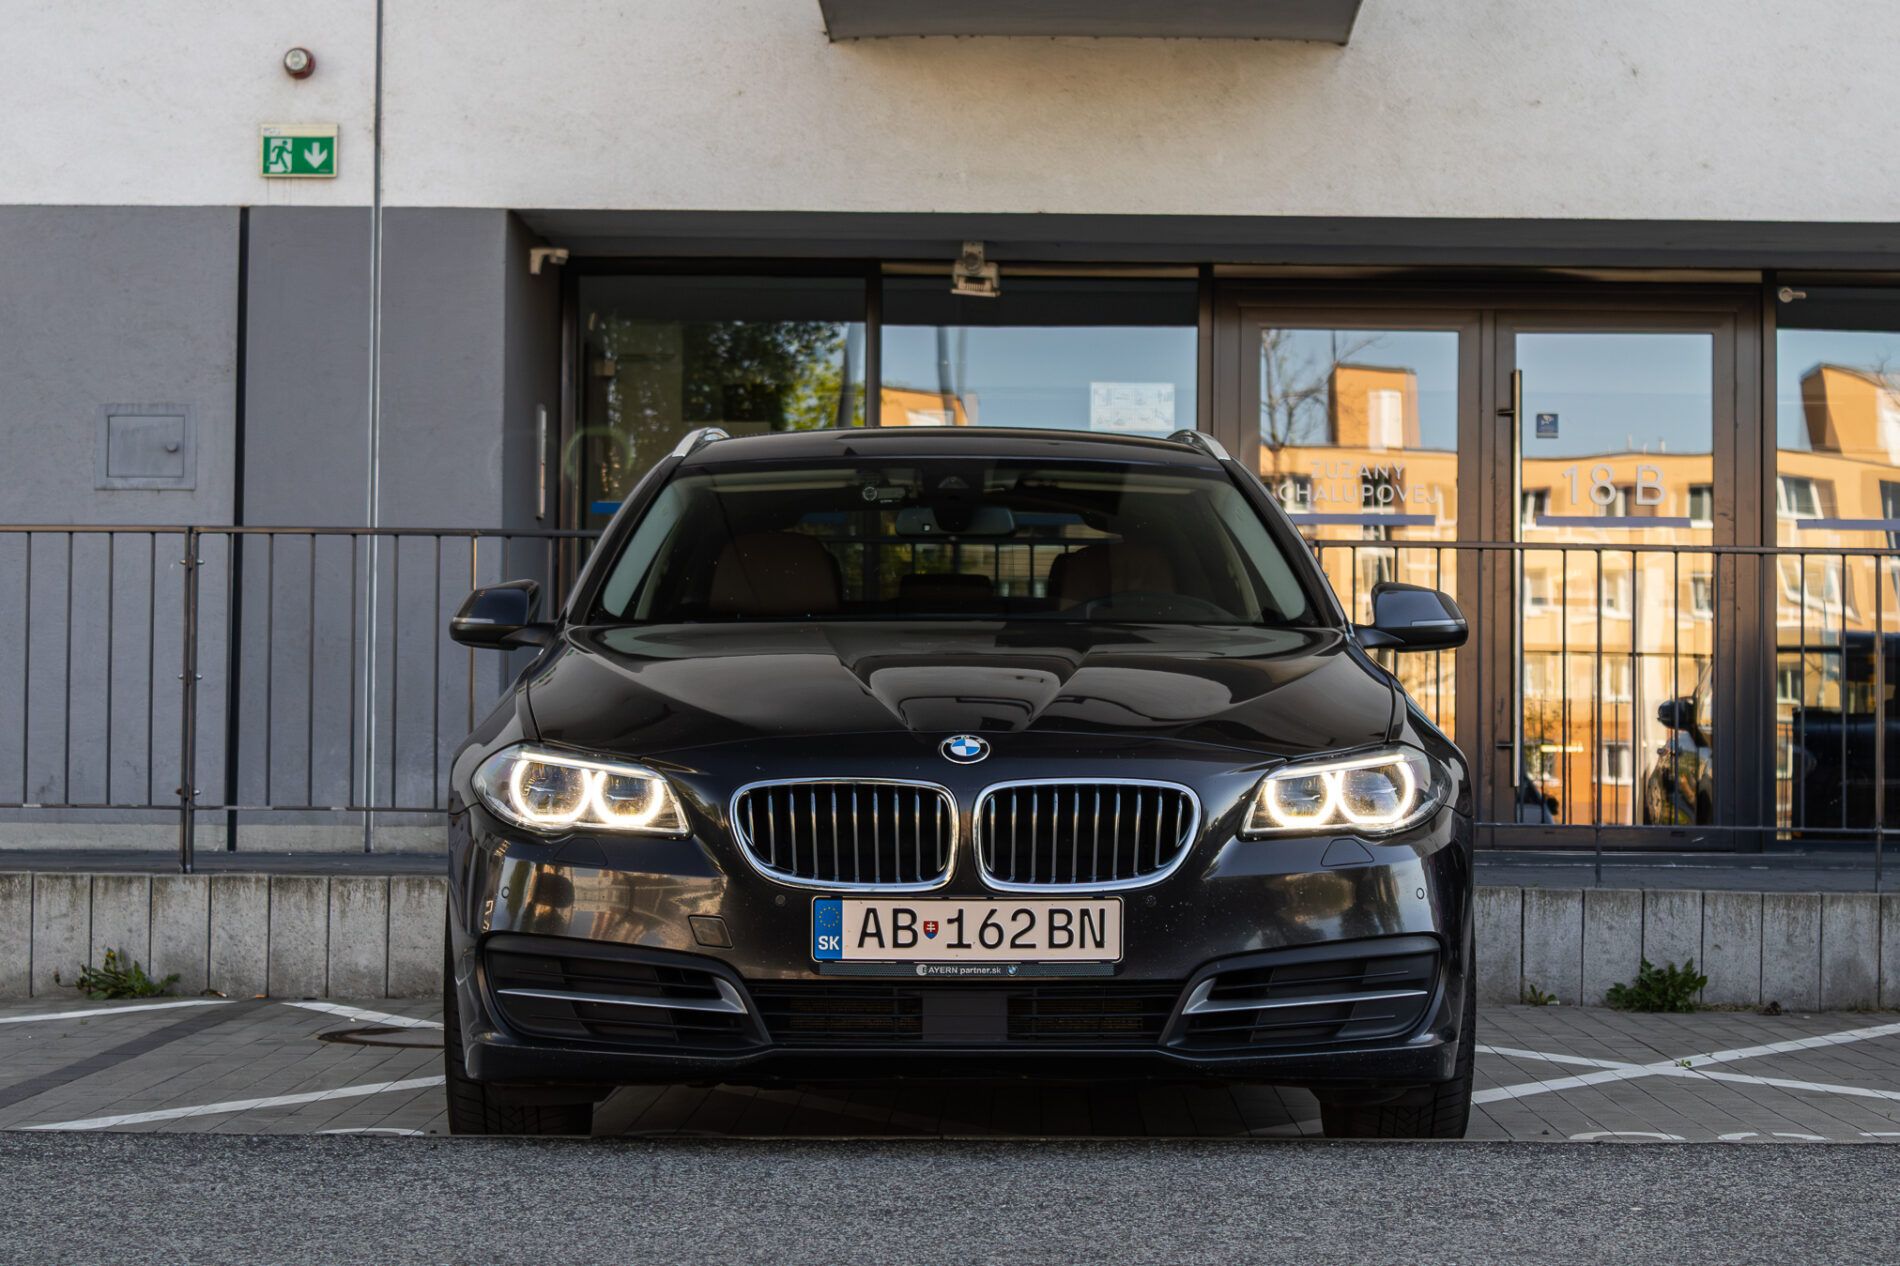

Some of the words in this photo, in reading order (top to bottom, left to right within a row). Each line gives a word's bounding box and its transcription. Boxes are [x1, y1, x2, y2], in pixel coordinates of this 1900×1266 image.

[1311, 461, 1405, 479] ZUZANY
[1278, 483, 1440, 503] CHALUPOVEJ
[1562, 463, 1617, 506] 18
[1636, 463, 1666, 506] B
[857, 907, 918, 949] AB
[946, 908, 1106, 949] 162BN
[818, 935, 840, 950] SK
[960, 966, 1002, 975] partner.sk
